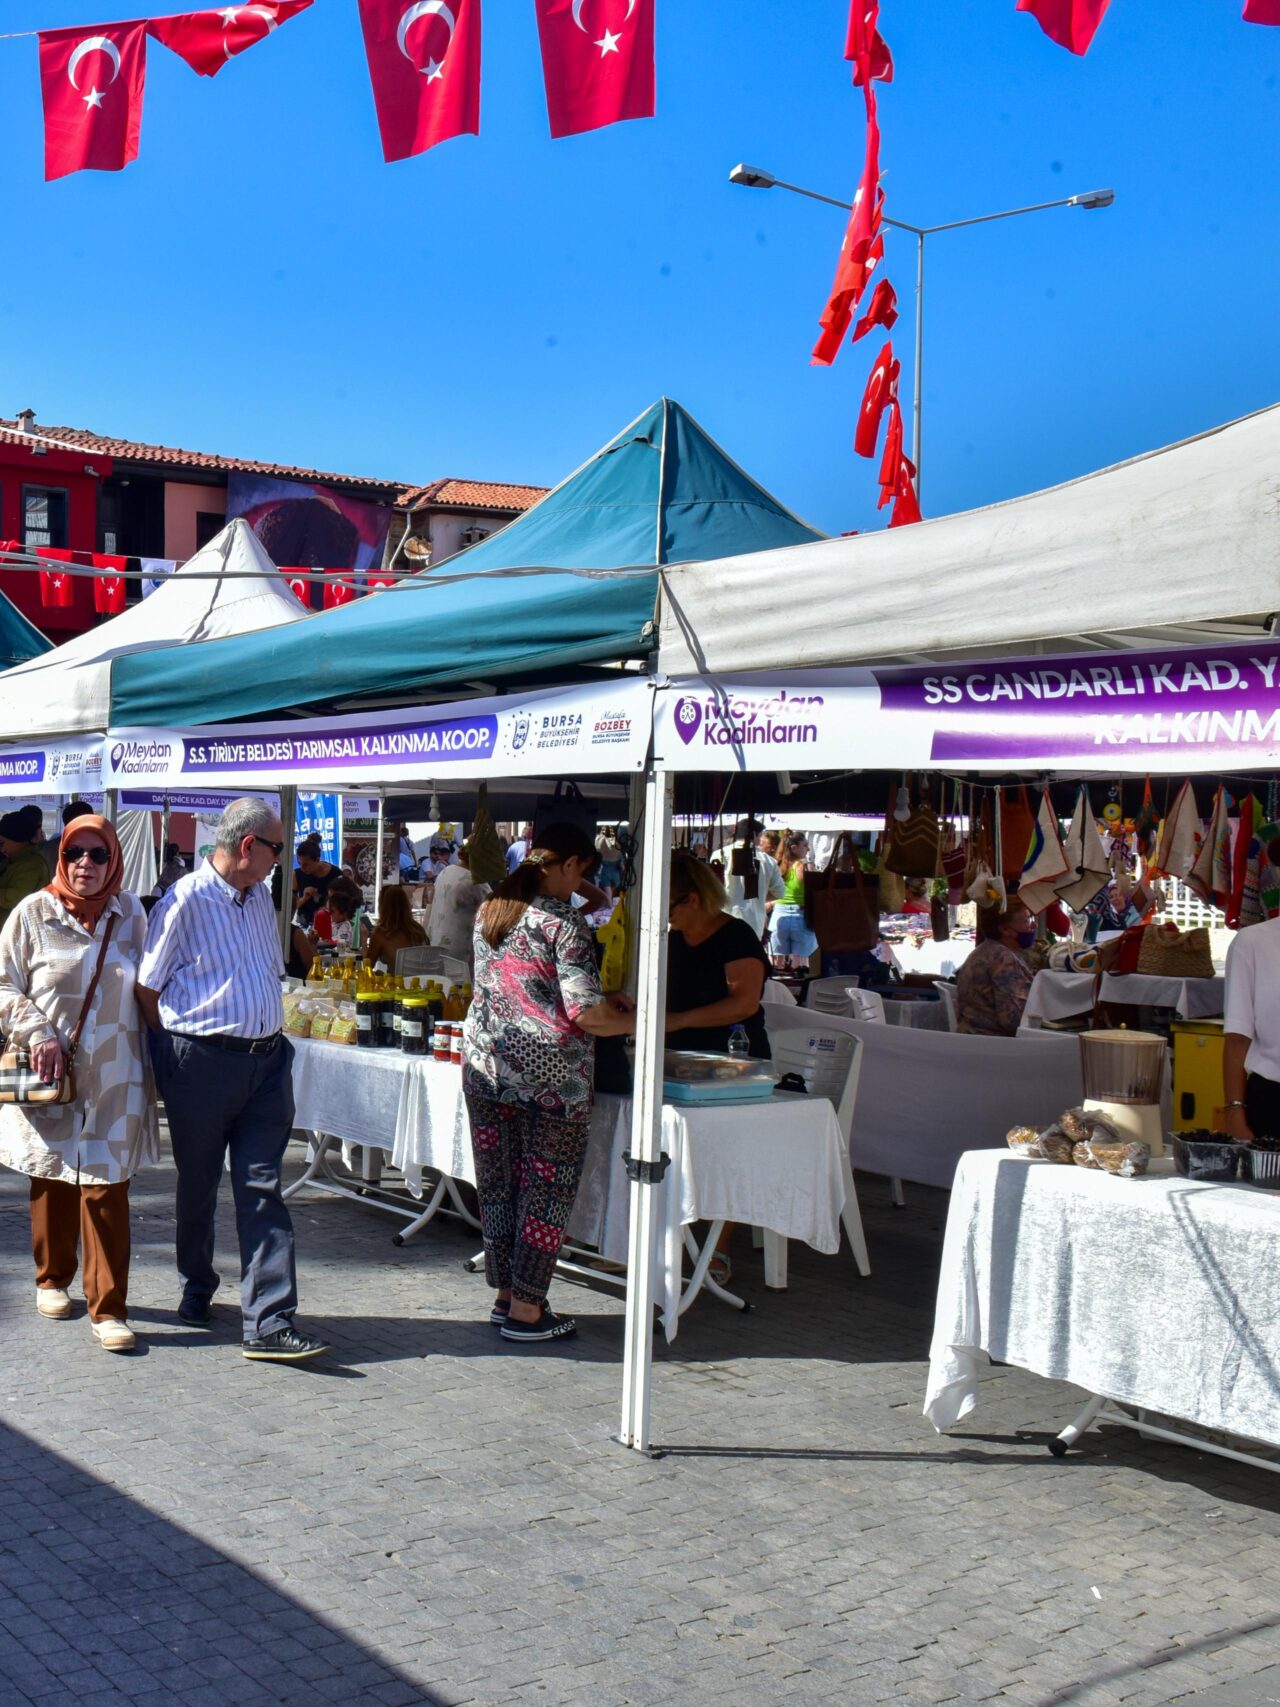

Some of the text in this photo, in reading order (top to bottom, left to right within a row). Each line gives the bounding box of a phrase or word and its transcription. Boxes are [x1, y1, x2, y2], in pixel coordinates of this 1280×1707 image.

[923, 656, 1280, 705] SS CANDARLI KAD. Y
[704, 690, 824, 725] Meydan
[542, 713, 583, 728] BURSA
[594, 720, 632, 731] BOZBEY
[703, 720, 818, 745] Kadınların
[124, 740, 172, 762] Meydan
[188, 727, 490, 764] S.S. TİRİLYE BELDESİ TARIMSAL KALKINMA KOOP.
[537, 736, 578, 749] BELEDİYESİ
[15, 759, 38, 775] KOOP.
[121, 759, 169, 773] Kadınların
